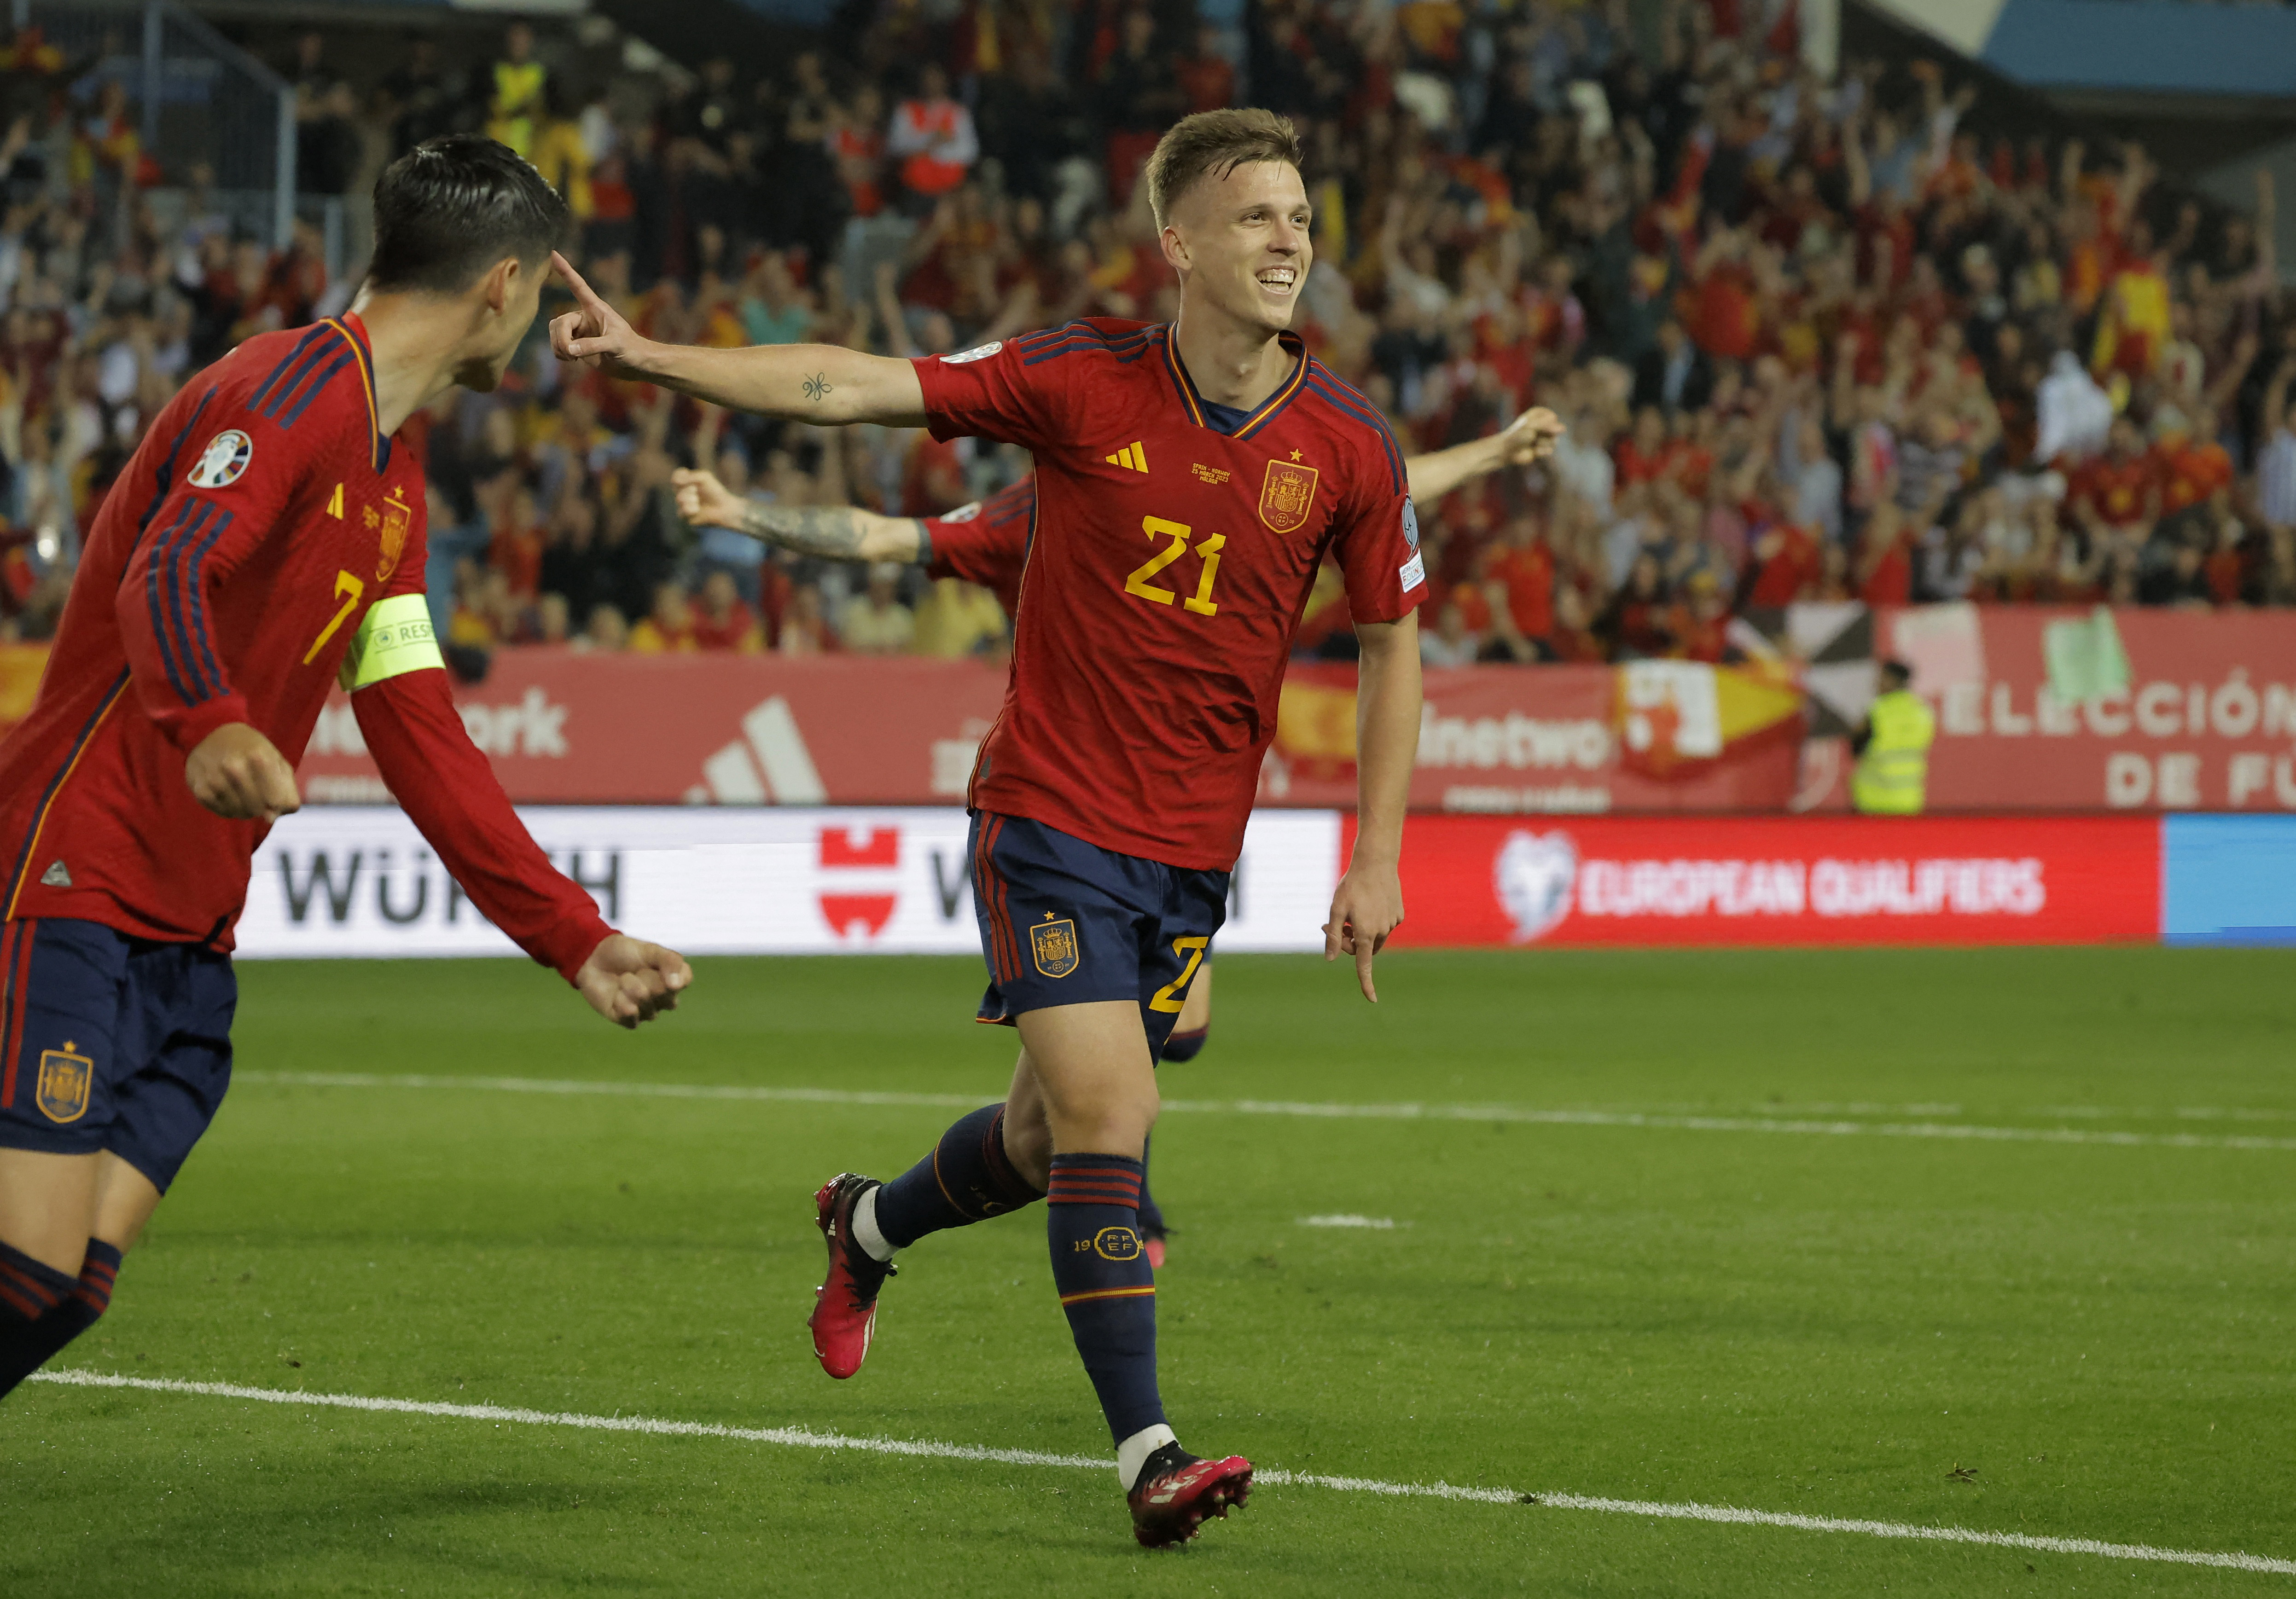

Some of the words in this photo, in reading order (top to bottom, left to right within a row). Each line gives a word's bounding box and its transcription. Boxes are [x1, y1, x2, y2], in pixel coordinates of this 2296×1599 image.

[1192, 463, 1207, 471] SPAIN
[1211, 468, 1231, 477] NORWAY
[1199, 470, 1215, 478] MARCH
[1215, 475, 1229, 483] 2023
[1125, 515, 1226, 616] 21
[303, 569, 364, 665] 7
[2105, 752, 2201, 808] DE
[279, 851, 619, 922] WÜH
[1580, 859, 1805, 917] EUROPEAN
[1810, 858, 2044, 917] QUALIFIERS
[1149, 936, 1209, 1013] 2
[1075, 1239, 1091, 1252] 19
